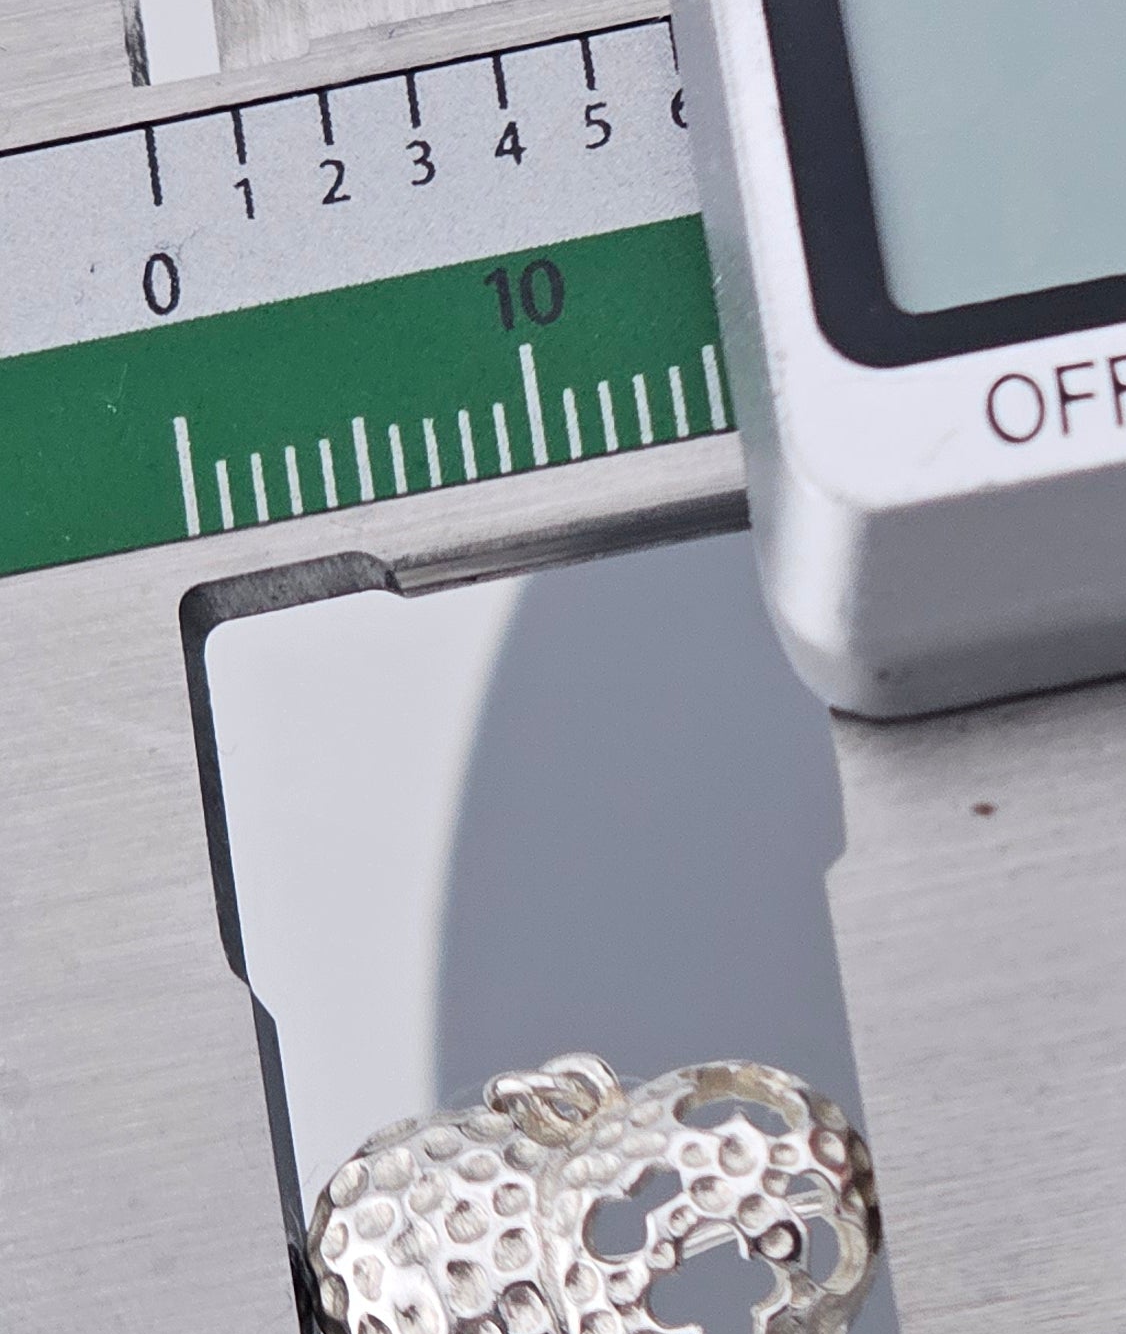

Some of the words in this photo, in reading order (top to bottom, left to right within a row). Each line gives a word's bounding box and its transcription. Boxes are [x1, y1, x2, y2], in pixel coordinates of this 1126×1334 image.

[234, 177, 256, 220] 1
[319, 158, 351, 205] 2
[406, 140, 436, 186] 3
[494, 121, 526, 166] 4
[584, 104, 611, 149] 5
[143, 252, 181, 316] 0
[484, 258, 565, 330] 10
